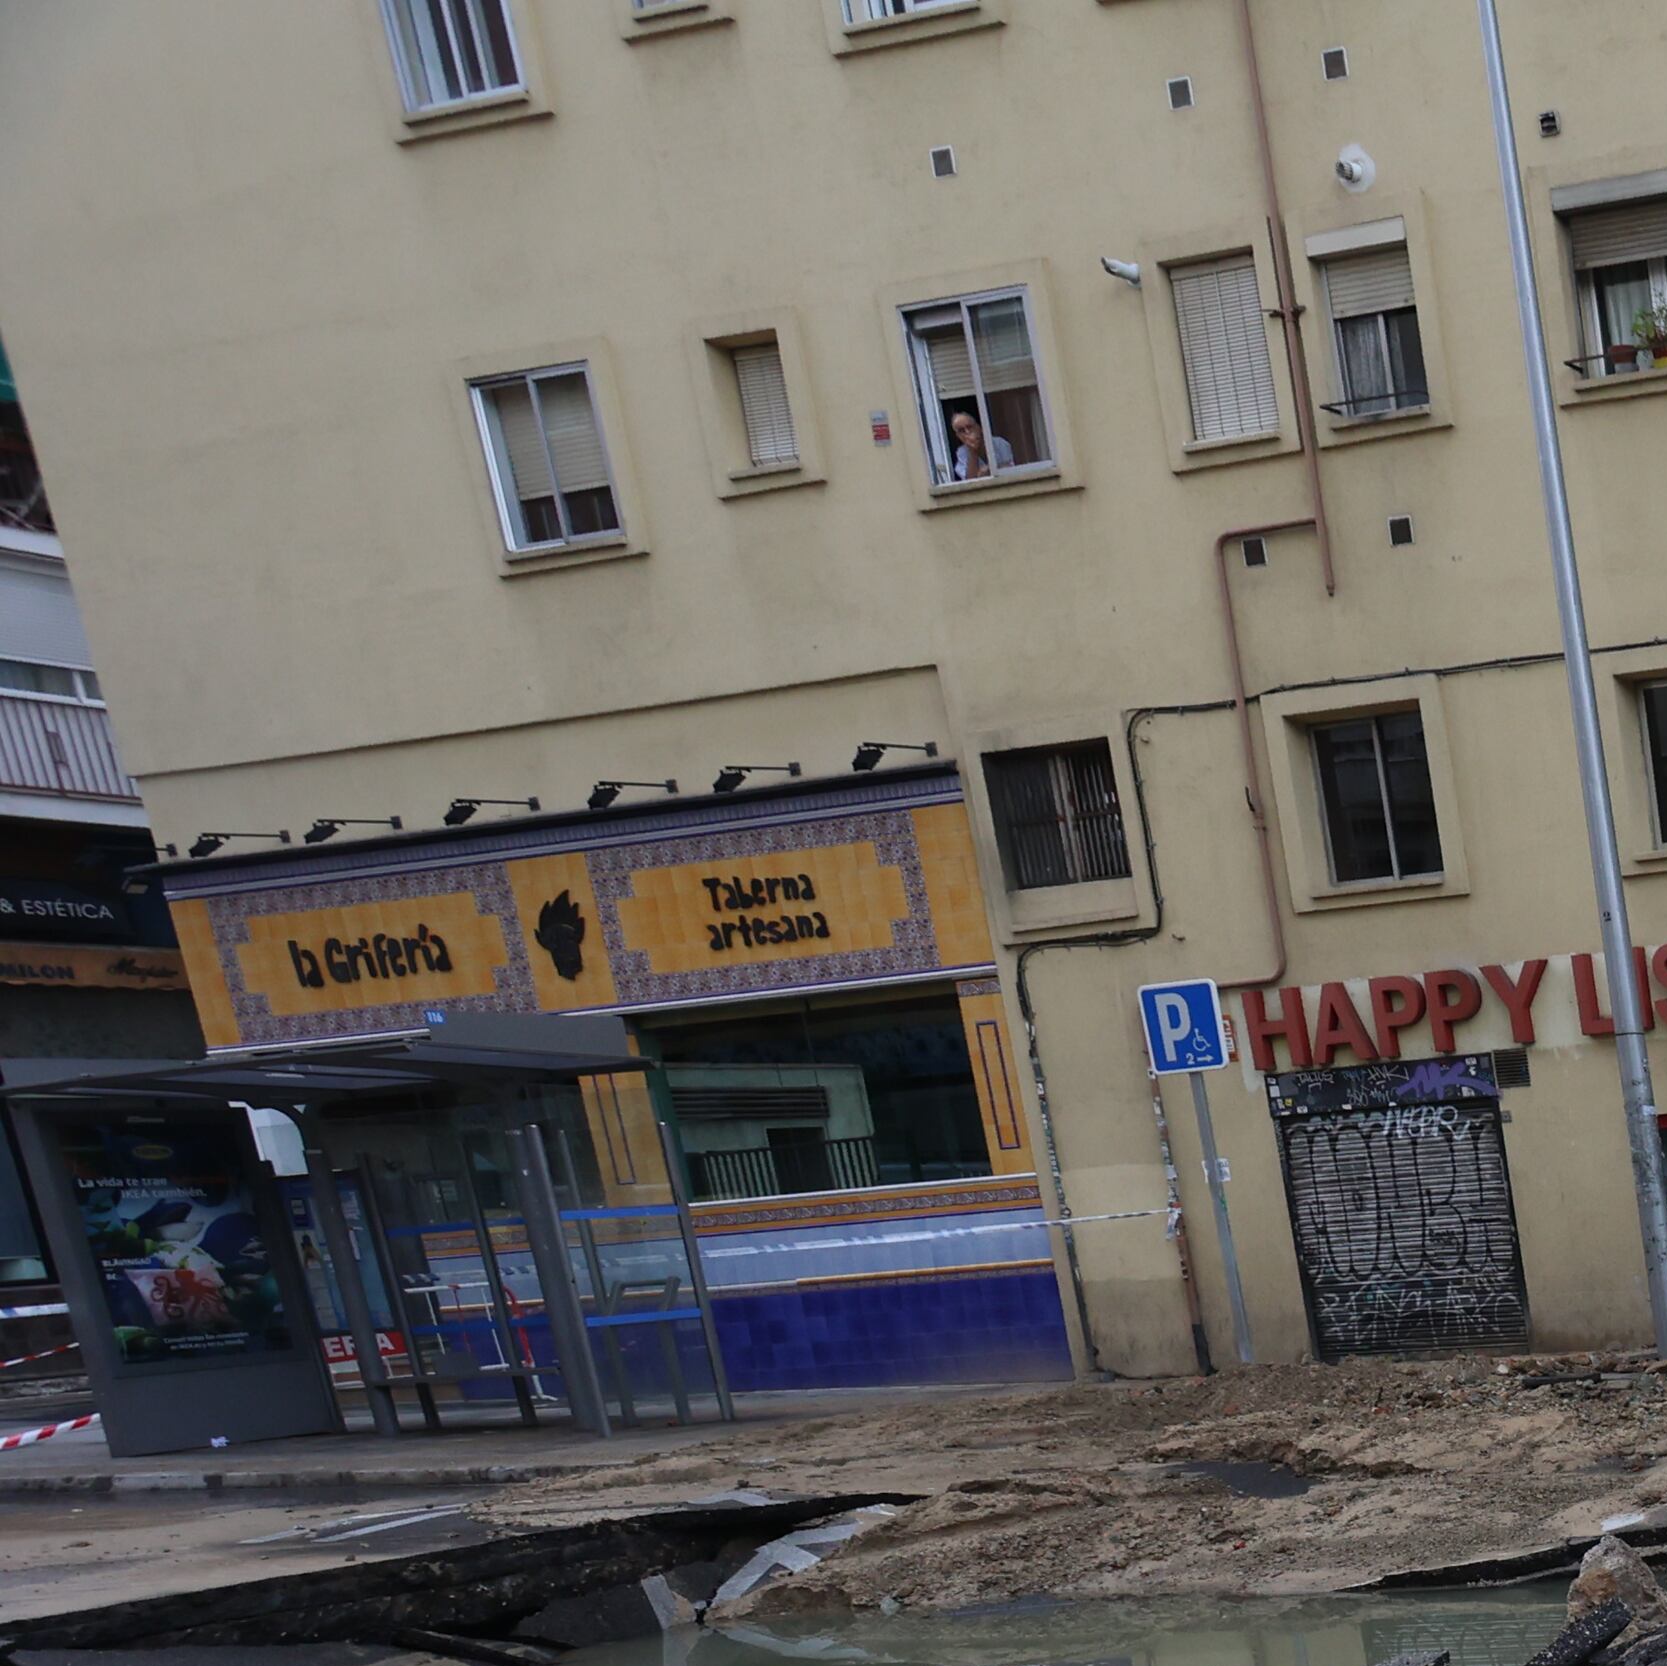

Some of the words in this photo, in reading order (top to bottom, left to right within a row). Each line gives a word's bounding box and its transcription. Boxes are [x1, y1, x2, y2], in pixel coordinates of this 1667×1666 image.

[21, 898, 115, 920] ESTÉTICA
[702, 874, 817, 912] Taberna
[706, 911, 832, 951] artesana
[286, 940, 325, 988] la
[324, 923, 454, 984] Grifería
[1153, 992, 1191, 1062] P
[1241, 958, 1548, 1071] HAPPY
[1185, 1053, 1196, 1065] 2
